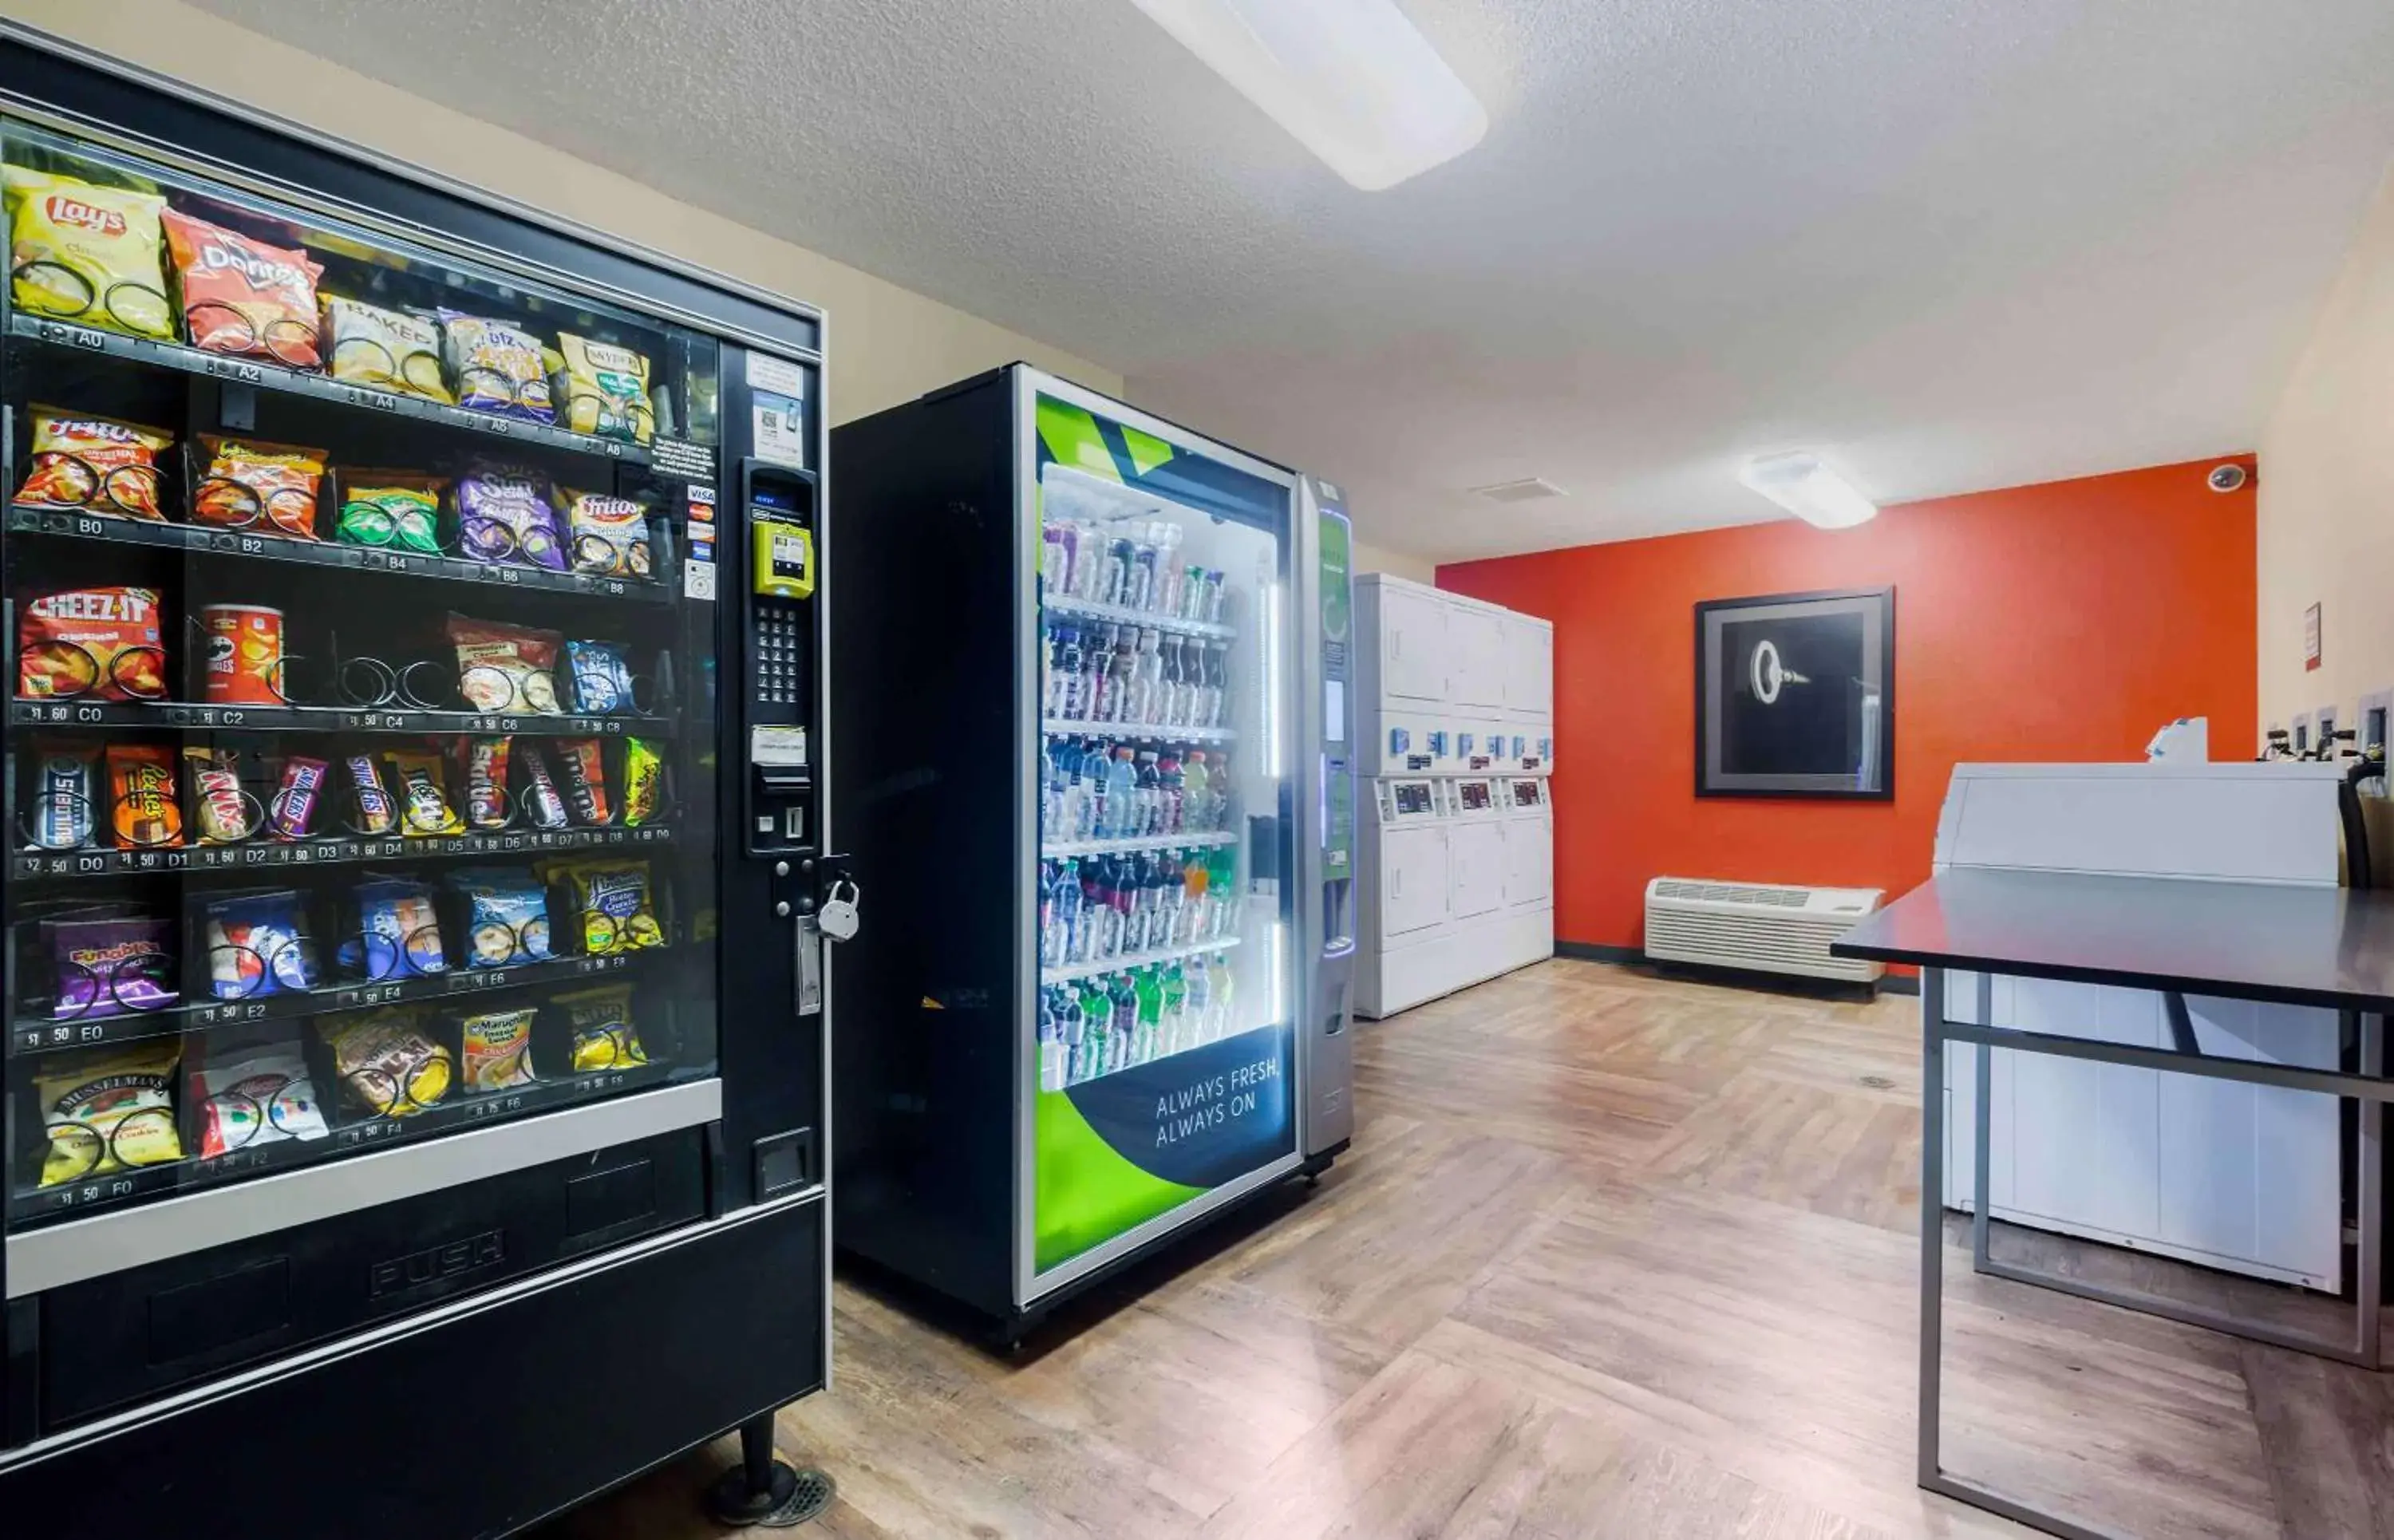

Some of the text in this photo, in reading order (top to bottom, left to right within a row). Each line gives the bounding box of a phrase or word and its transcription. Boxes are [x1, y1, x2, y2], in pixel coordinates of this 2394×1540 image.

[203, 245, 310, 289] Doritos
[79, 332, 102, 348] A0
[239, 367, 260, 381] A2
[376, 396, 394, 409] A4
[606, 444, 621, 456] A8
[690, 489, 715, 502] VISA
[80, 522, 102, 534] B0
[243, 539, 263, 553] B2
[389, 558, 406, 569] B4
[610, 583, 624, 594] B8
[79, 707, 101, 722] C0
[223, 712, 244, 725] C2
[385, 715, 403, 729] C4
[502, 719, 518, 731] C6
[607, 722, 620, 733] C8
[448, 840, 464, 852] D5
[504, 838, 520, 849] D6
[558, 835, 573, 846] D7
[318, 847, 337, 859] D3
[385, 843, 402, 854] D4
[168, 853, 188, 867] D1
[246, 850, 266, 863] D2
[79, 857, 103, 871] D0
[490, 973, 505, 985] E6
[385, 987, 400, 1000] E4
[247, 1005, 266, 1018] E2
[81, 1025, 103, 1040] E0
[1156, 1076, 1225, 1119] ALWAYS
[1156, 1091, 1256, 1148] ALWAYS ON
[387, 1123, 402, 1135] F4
[251, 1151, 267, 1167] F2
[113, 1181, 132, 1195] F0
[370, 1231, 506, 1297] PUSH
